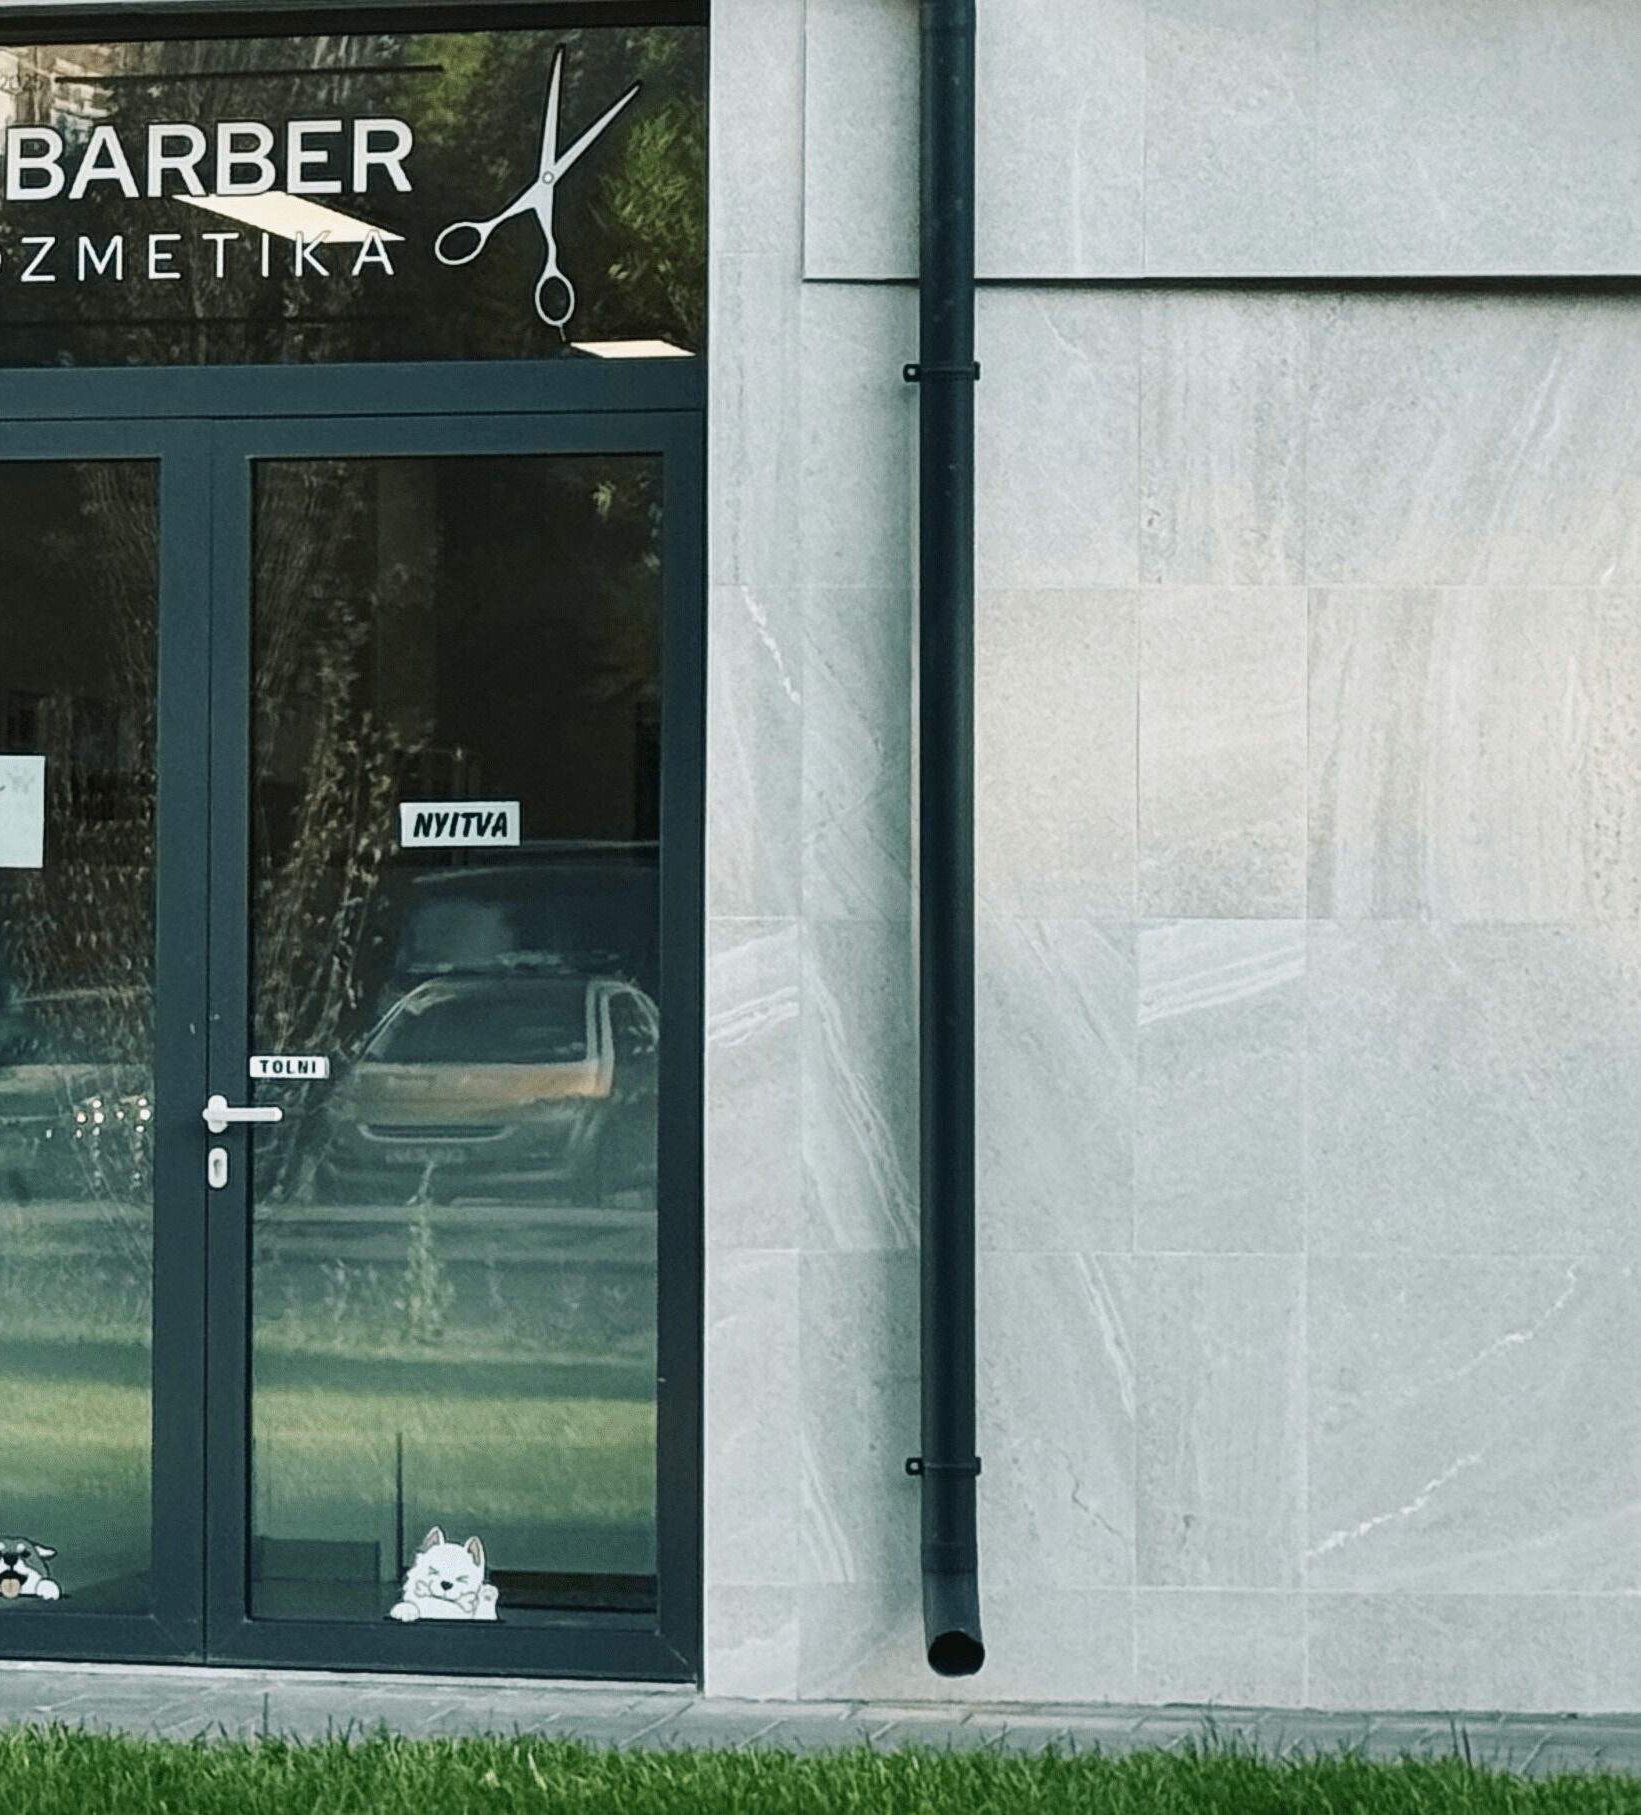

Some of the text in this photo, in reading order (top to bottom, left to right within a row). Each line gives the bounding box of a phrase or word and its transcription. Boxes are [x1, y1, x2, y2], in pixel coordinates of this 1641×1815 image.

[5, 118, 414, 200] BARBER
[413, 811, 508, 838] NYITVA
[259, 1059, 317, 1075] TOLNI
